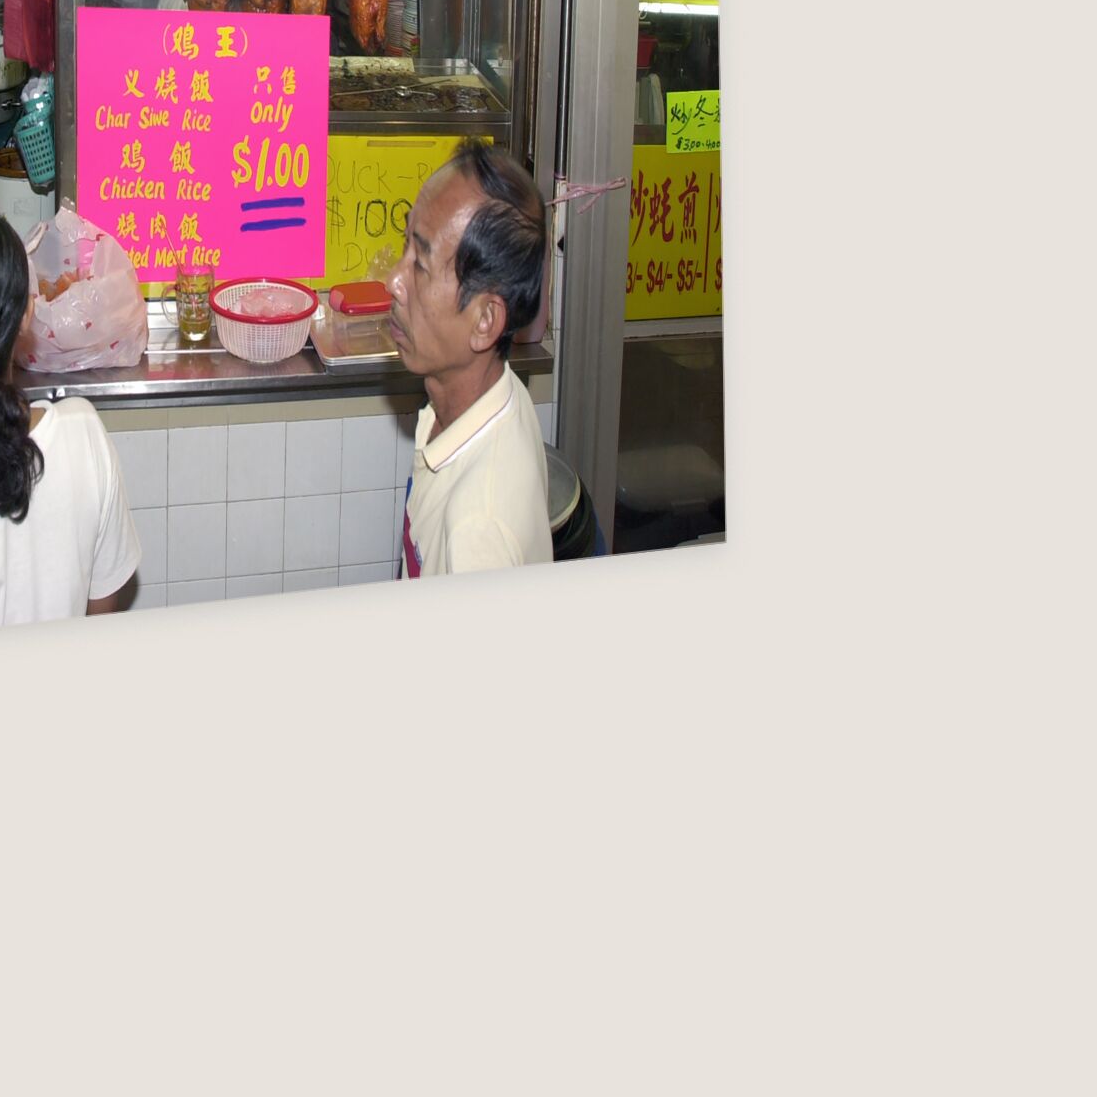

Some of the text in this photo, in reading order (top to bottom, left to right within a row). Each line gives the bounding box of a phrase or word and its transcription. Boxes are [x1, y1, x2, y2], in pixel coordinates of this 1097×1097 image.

[95, 106, 212, 132] Char Siwe Rice
[231, 135, 310, 192] $1.00
[99, 176, 212, 201] Chicken Rice
[192, 246, 221, 266] Rice
